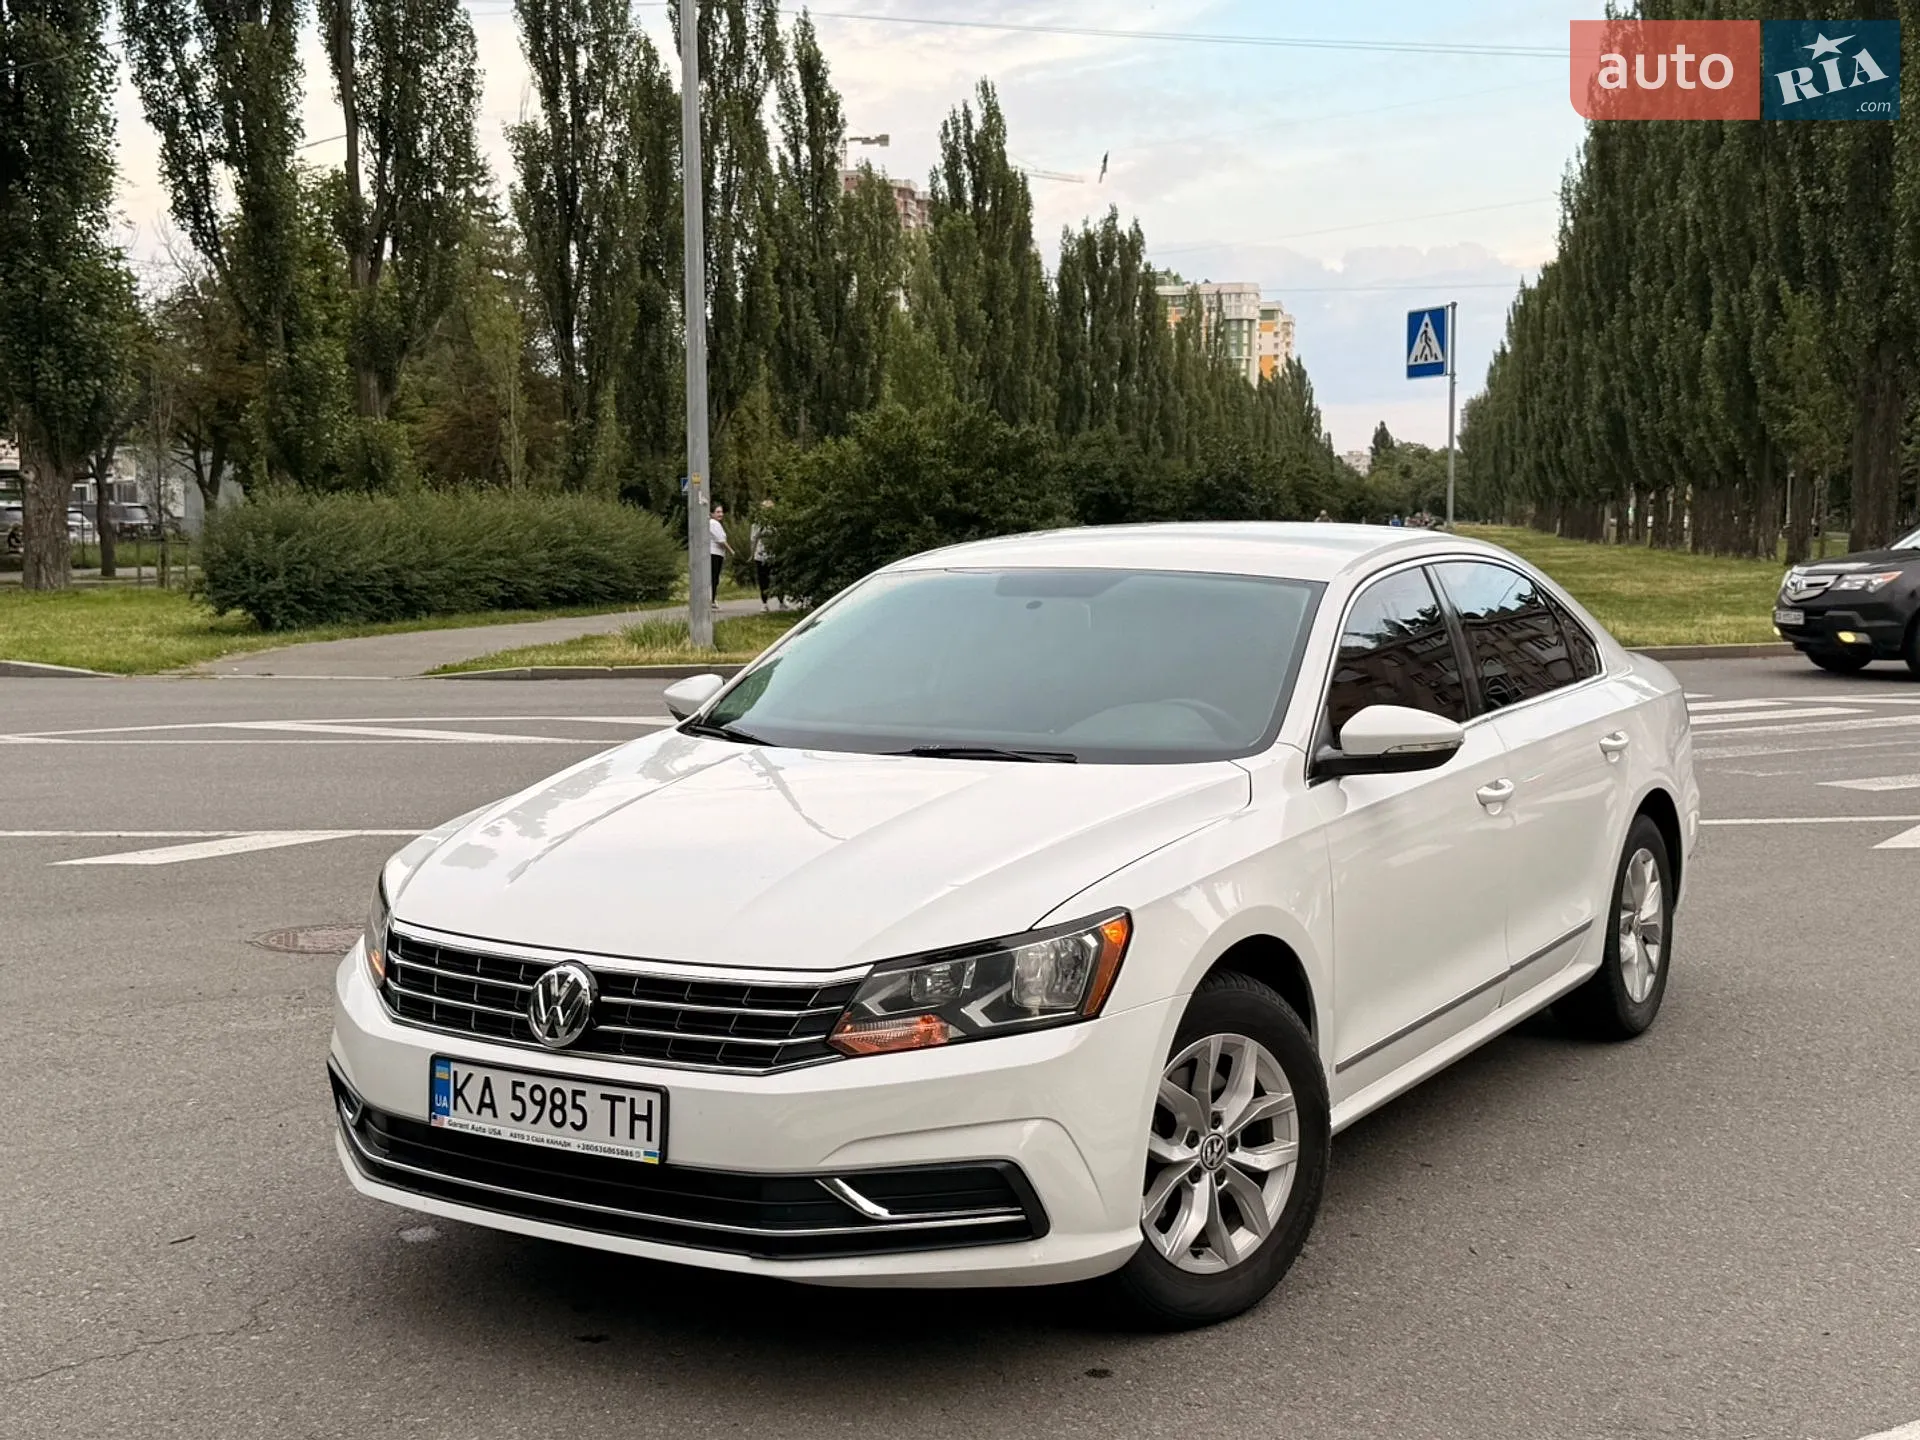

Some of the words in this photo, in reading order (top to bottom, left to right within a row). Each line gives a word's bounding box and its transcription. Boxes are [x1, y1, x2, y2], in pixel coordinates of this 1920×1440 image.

[434, 1093, 448, 1109] UA
[453, 1070, 499, 1119] KA
[510, 1080, 588, 1131] 5985
[600, 1093, 653, 1142] TH
[471, 1124, 486, 1133] Auto
[488, 1127, 502, 1136] USA
